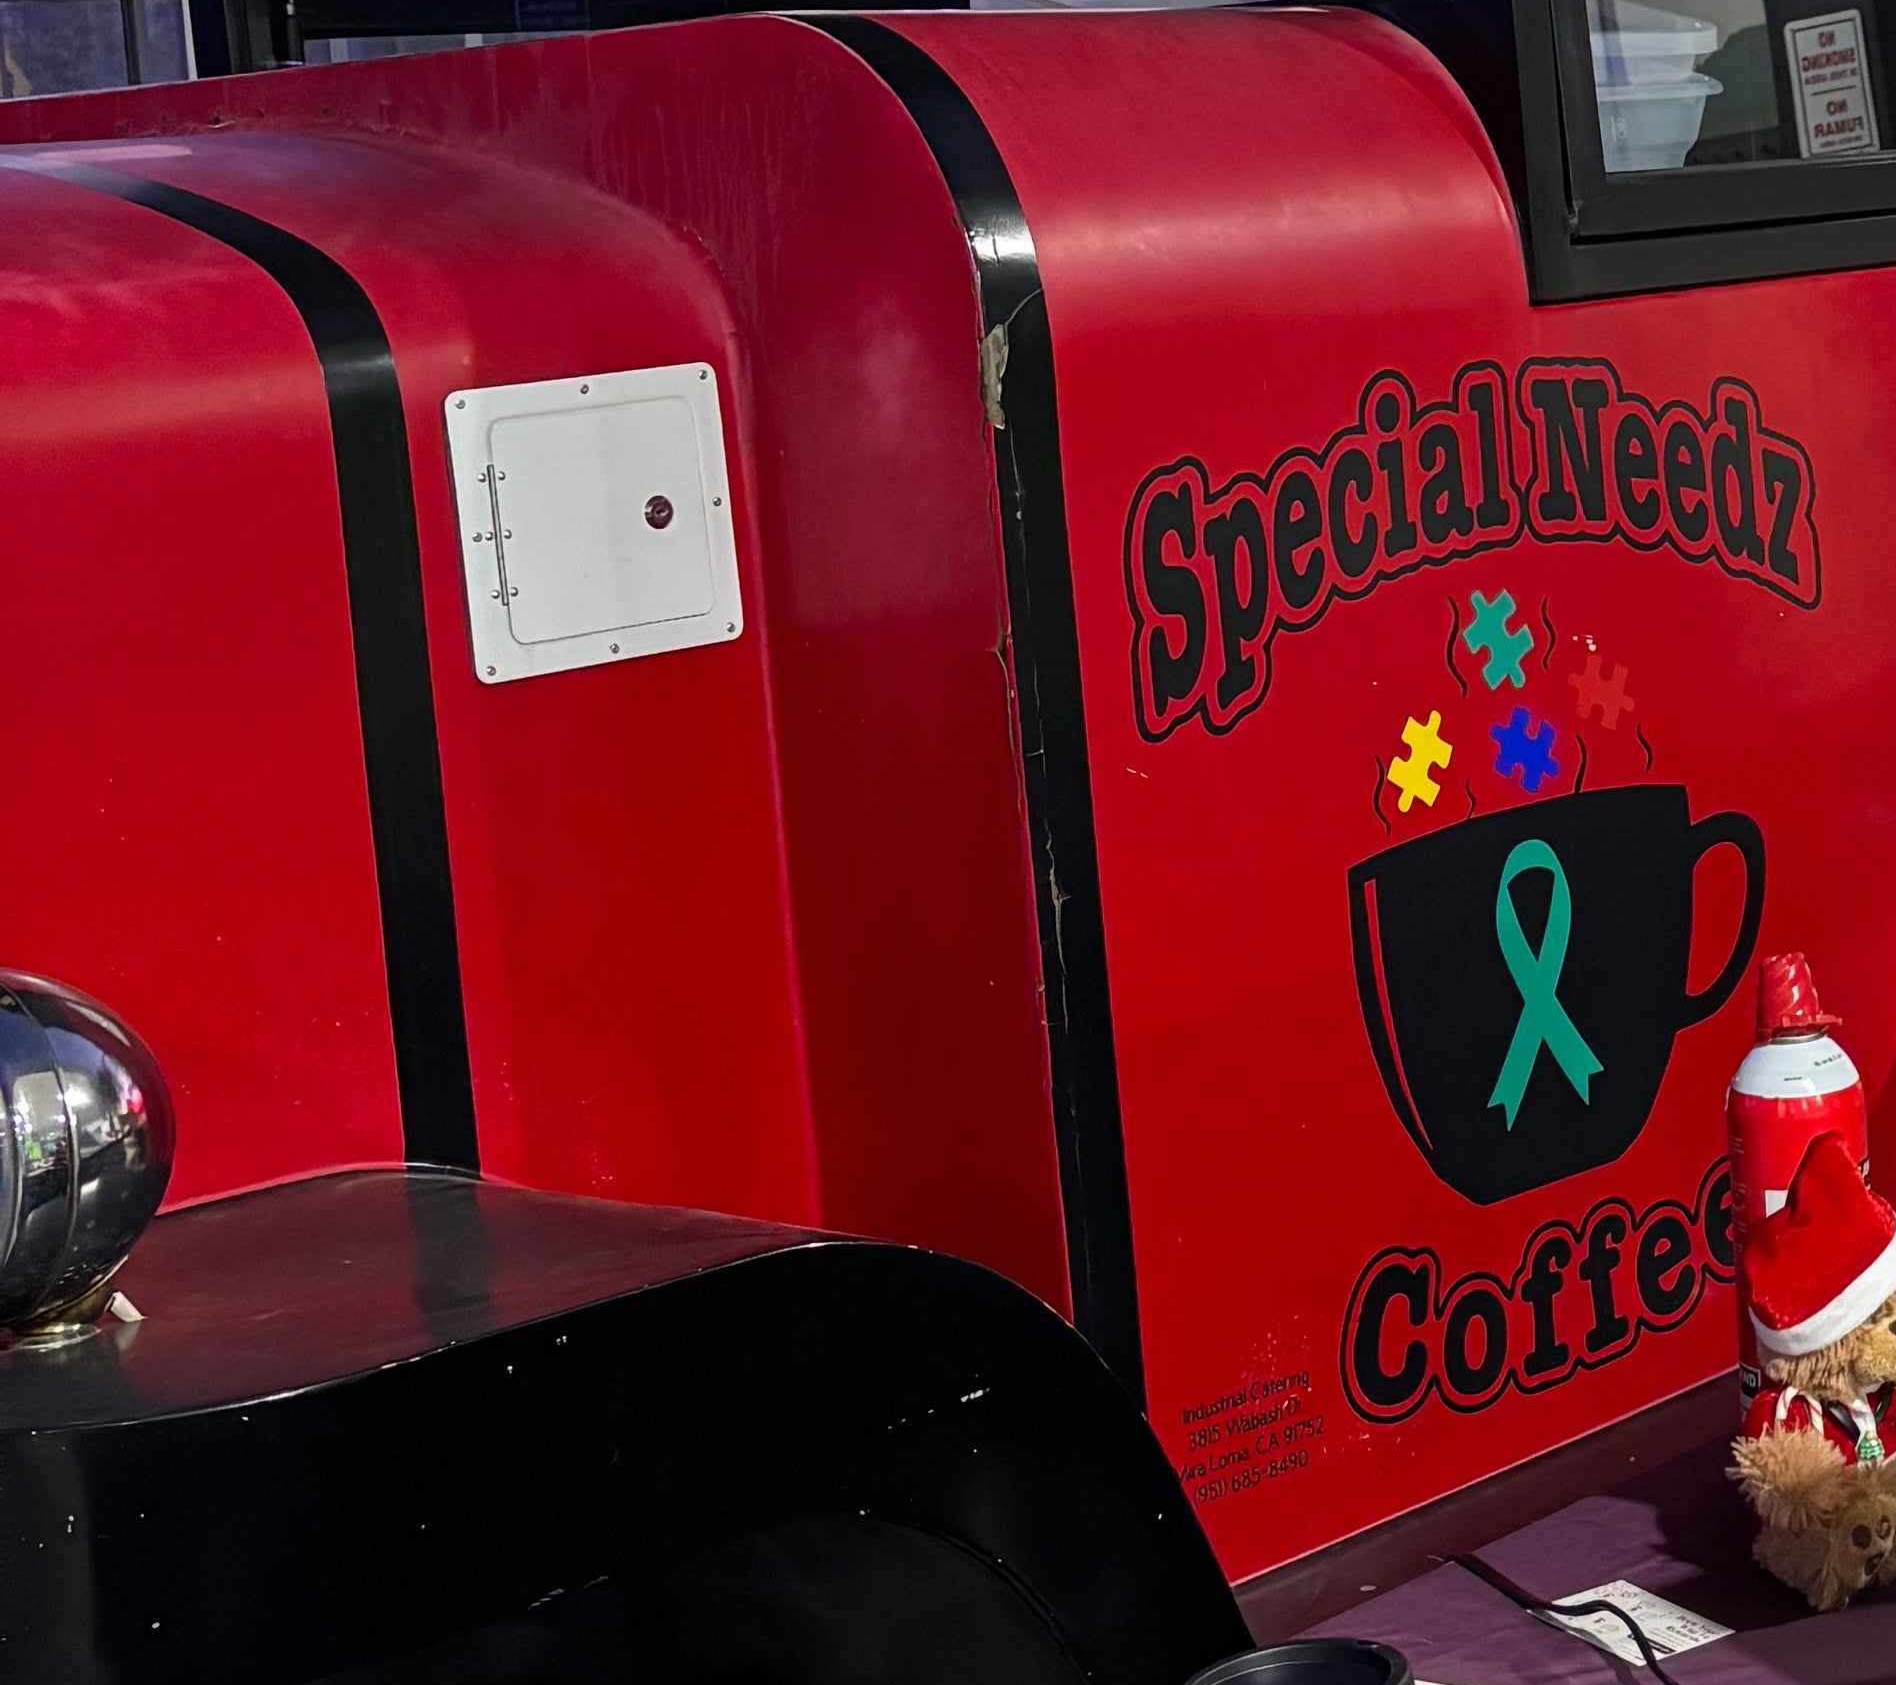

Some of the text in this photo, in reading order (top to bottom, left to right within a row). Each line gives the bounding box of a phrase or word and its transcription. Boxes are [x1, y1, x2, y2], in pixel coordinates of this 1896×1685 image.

[1124, 357, 1821, 743] Special Needz
[1183, 1387, 1247, 1424] Industrial
[1188, 1424, 1220, 1452] 3815
[1226, 1405, 1283, 1437] Wabash
[1255, 1432, 1280, 1455] CA
[1283, 1415, 1324, 1442] 91752
[1231, 1449, 1310, 1493] 685-8490
